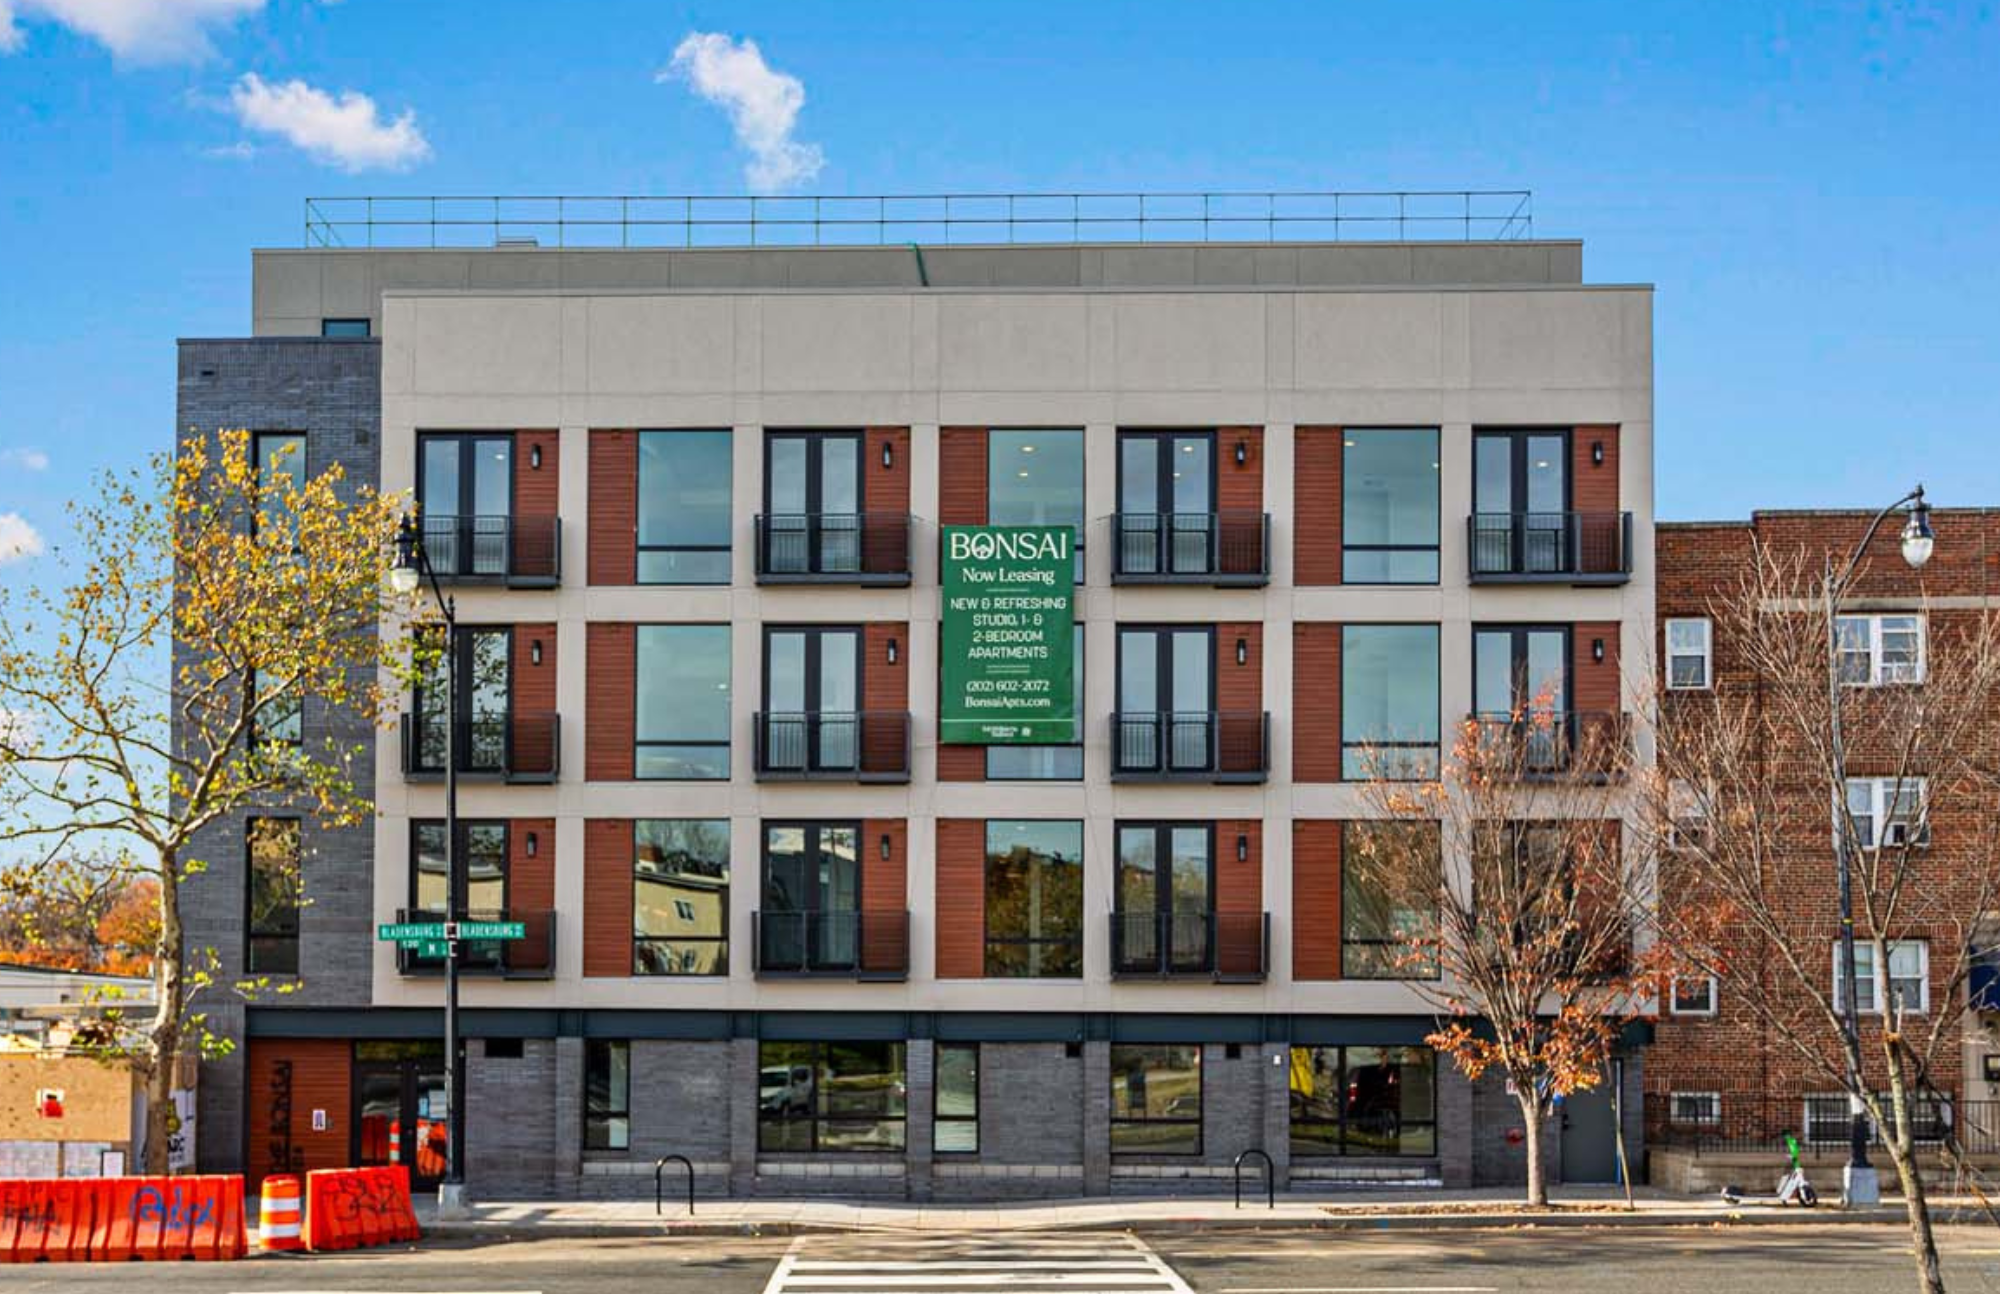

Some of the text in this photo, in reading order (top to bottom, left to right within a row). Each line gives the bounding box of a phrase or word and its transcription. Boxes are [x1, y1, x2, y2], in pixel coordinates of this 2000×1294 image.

[950, 532, 1067, 560] BONSAI
[962, 567, 1055, 585] Now Leasing
[950, 597, 1066, 610] NEW & REFRESHING
[1033, 614, 1043, 626] &
[973, 630, 1043, 642] 2-BEDROOM
[968, 646, 1048, 659] APARTMENTS
[966, 680, 1050, 692] (202) 602-2072
[965, 696, 1050, 709] BonsaiApts.com
